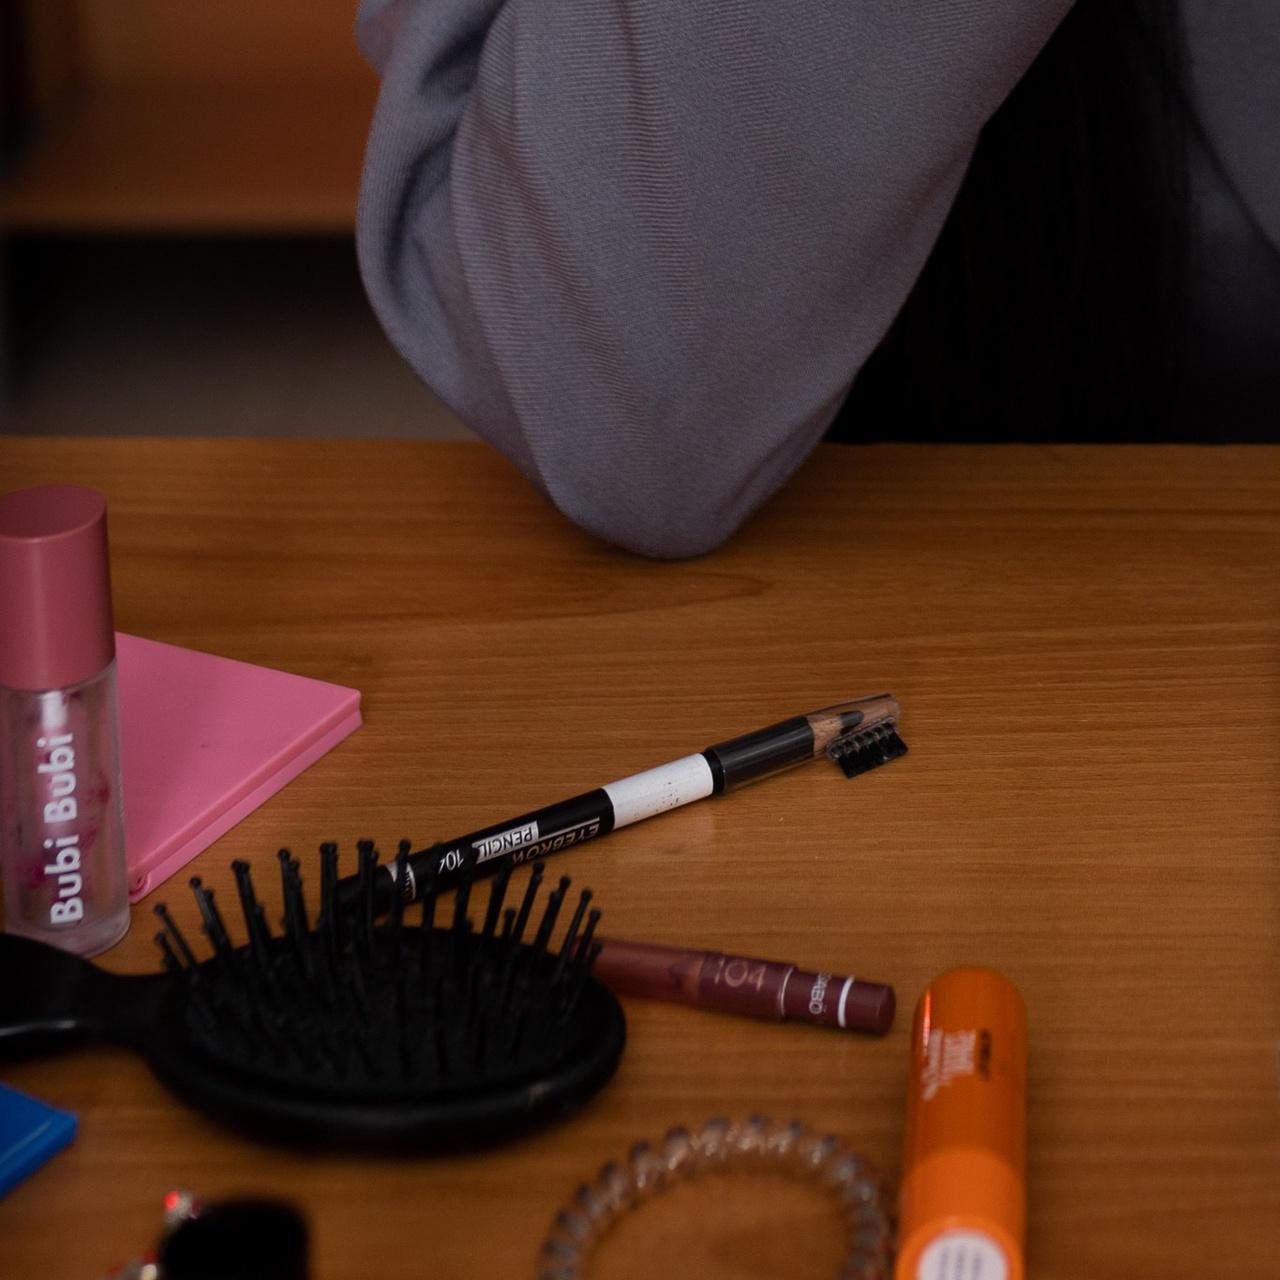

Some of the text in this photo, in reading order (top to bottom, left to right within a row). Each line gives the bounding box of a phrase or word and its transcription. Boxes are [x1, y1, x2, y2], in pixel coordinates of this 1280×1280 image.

[36, 733, 84, 924] Bubi Bubi
[480, 826, 533, 857] PENCIL
[713, 956, 767, 991] 104
